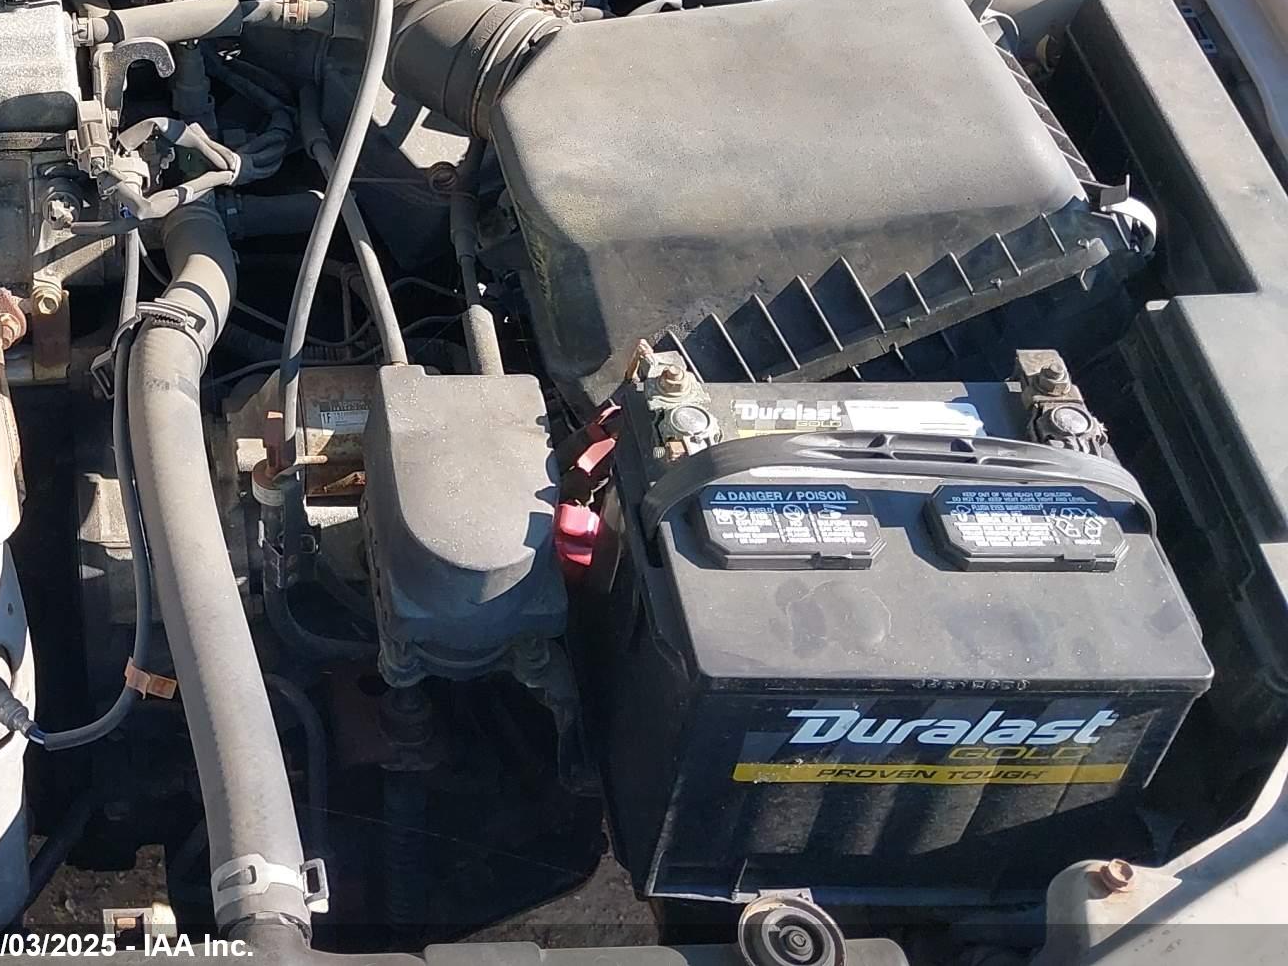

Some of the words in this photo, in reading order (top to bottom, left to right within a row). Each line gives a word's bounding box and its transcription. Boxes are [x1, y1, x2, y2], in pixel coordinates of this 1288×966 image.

[735, 402, 842, 420] Duralast
[796, 420, 842, 428] GOLD
[728, 492, 783, 501] DANGER
[798, 491, 847, 500] POISON
[787, 709, 1119, 745] Duralast
[948, 746, 1093, 760] GOLD
[815, 769, 937, 780] PROVEN
[948, 770, 1045, 780] TOUGH
